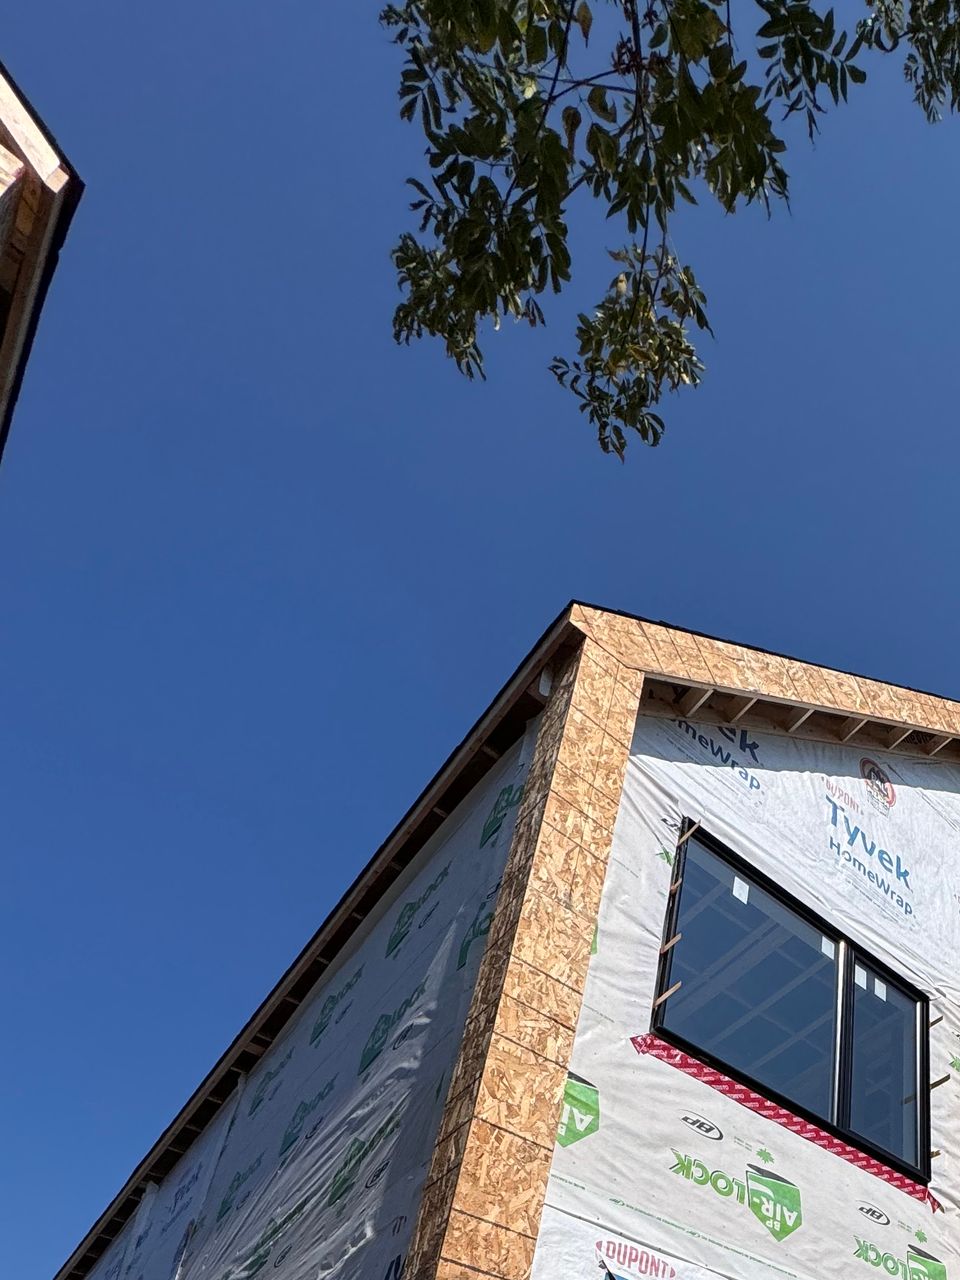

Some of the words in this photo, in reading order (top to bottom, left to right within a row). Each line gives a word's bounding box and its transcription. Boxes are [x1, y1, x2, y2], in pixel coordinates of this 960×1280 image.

[826, 794, 911, 890] Tyvek
[829, 836, 913, 915] HomeWrap
[681, 1115, 716, 1134] BP
[765, 1219, 782, 1232] BP
[858, 1205, 884, 1221] BP
[605, 1240, 670, 1279] DUPONT
